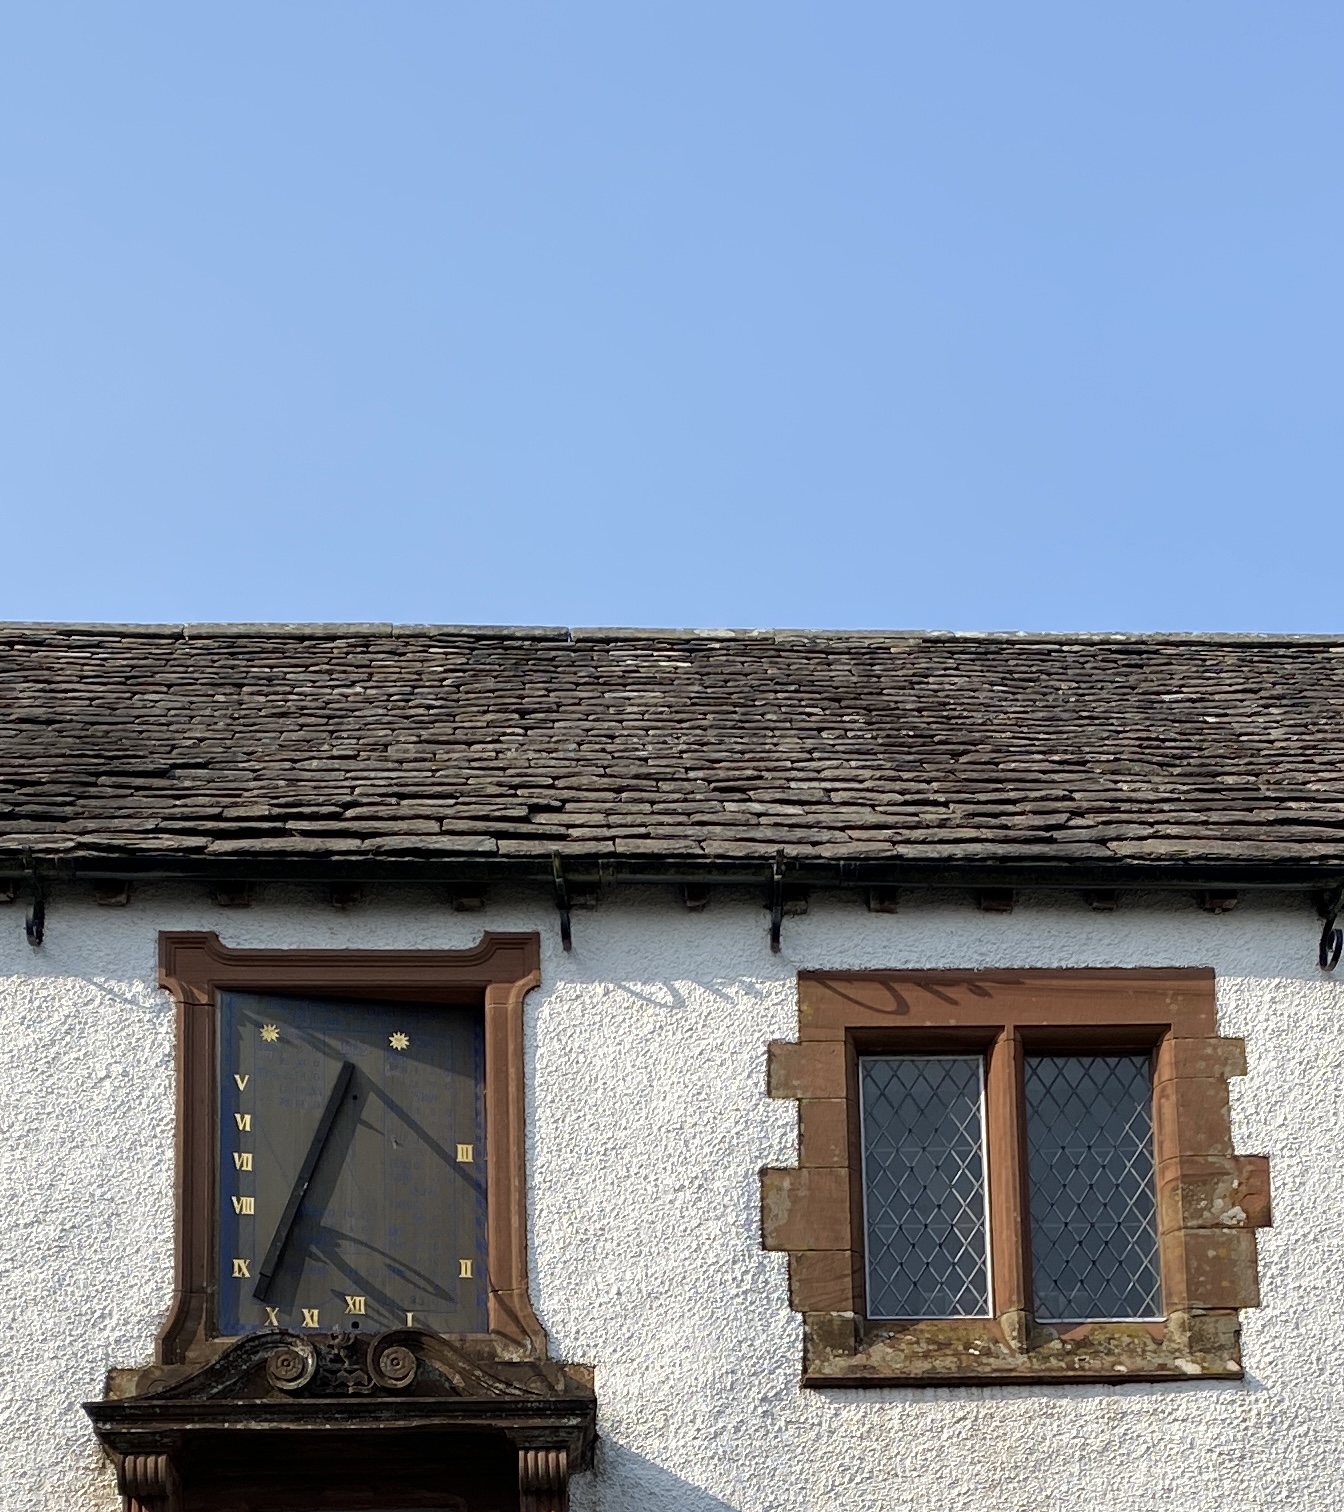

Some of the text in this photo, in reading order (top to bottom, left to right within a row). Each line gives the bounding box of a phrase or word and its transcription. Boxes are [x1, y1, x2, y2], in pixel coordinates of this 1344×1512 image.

[234, 1074, 249, 1091] V
[234, 1113, 251, 1131] VI
[233, 1152, 253, 1171] VII
[456, 1144, 474, 1163] III
[231, 1196, 255, 1215] VIII
[233, 1259, 251, 1278] IX
[458, 1259, 474, 1279] II
[345, 1296, 366, 1315] XII
[264, 1307, 280, 1327] X
[302, 1309, 320, 1328] XI
[406, 1312, 414, 1328] I
